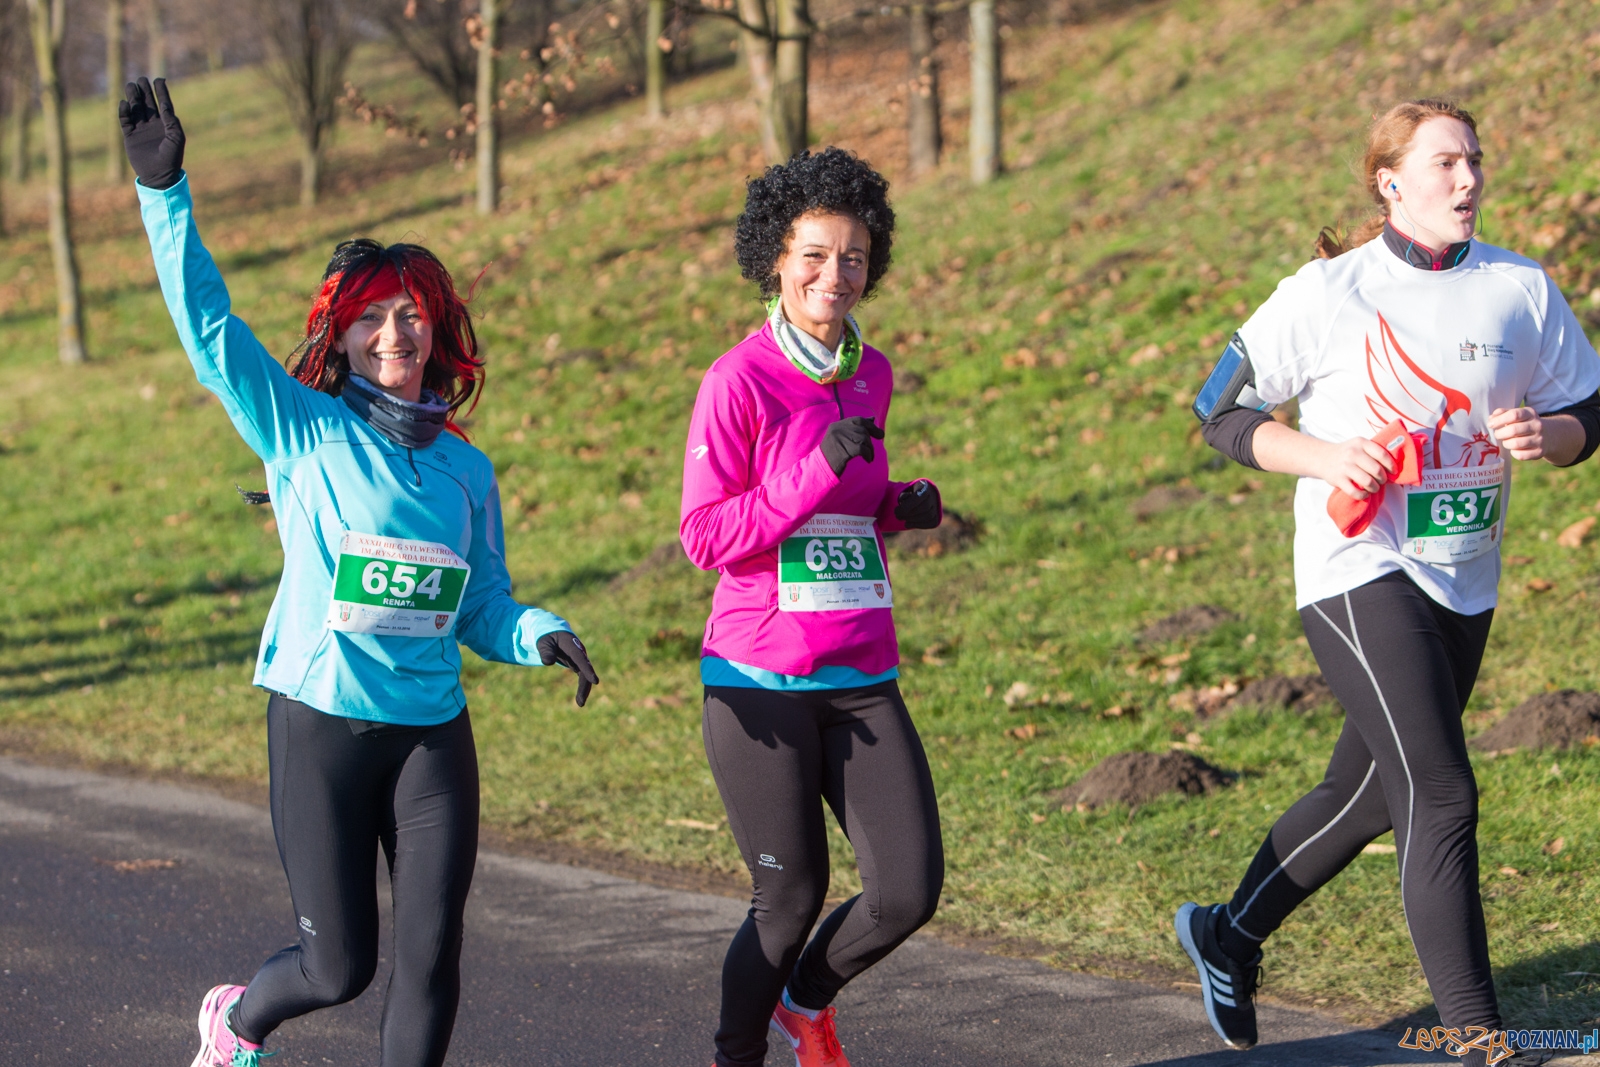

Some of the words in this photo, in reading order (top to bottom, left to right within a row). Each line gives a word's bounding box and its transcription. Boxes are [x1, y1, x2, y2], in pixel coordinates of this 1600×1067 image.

[1444, 472, 1463, 480] BIEG
[1464, 467, 1504, 478] SYLWESTRO
[1438, 480, 1478, 489] RYSZARDA
[1479, 476, 1503, 486] BURGIEL
[1430, 487, 1499, 526] 637
[815, 518, 832, 526] BIEG
[1446, 523, 1485, 533] WERONIKA
[799, 527, 810, 535] IM.
[358, 537, 382, 548] XXXII
[383, 541, 404, 551] BIEG
[405, 544, 456, 556] SYLWESTROW
[375, 550, 418, 562] RYSZARDA
[419, 555, 459, 566] BURGIELA
[804, 538, 866, 572] 653
[361, 560, 443, 600] 654
[816, 572, 862, 580] MAŁGORZATA
[383, 598, 416, 608] RENATA
[757, 859, 784, 871] Kalenji
